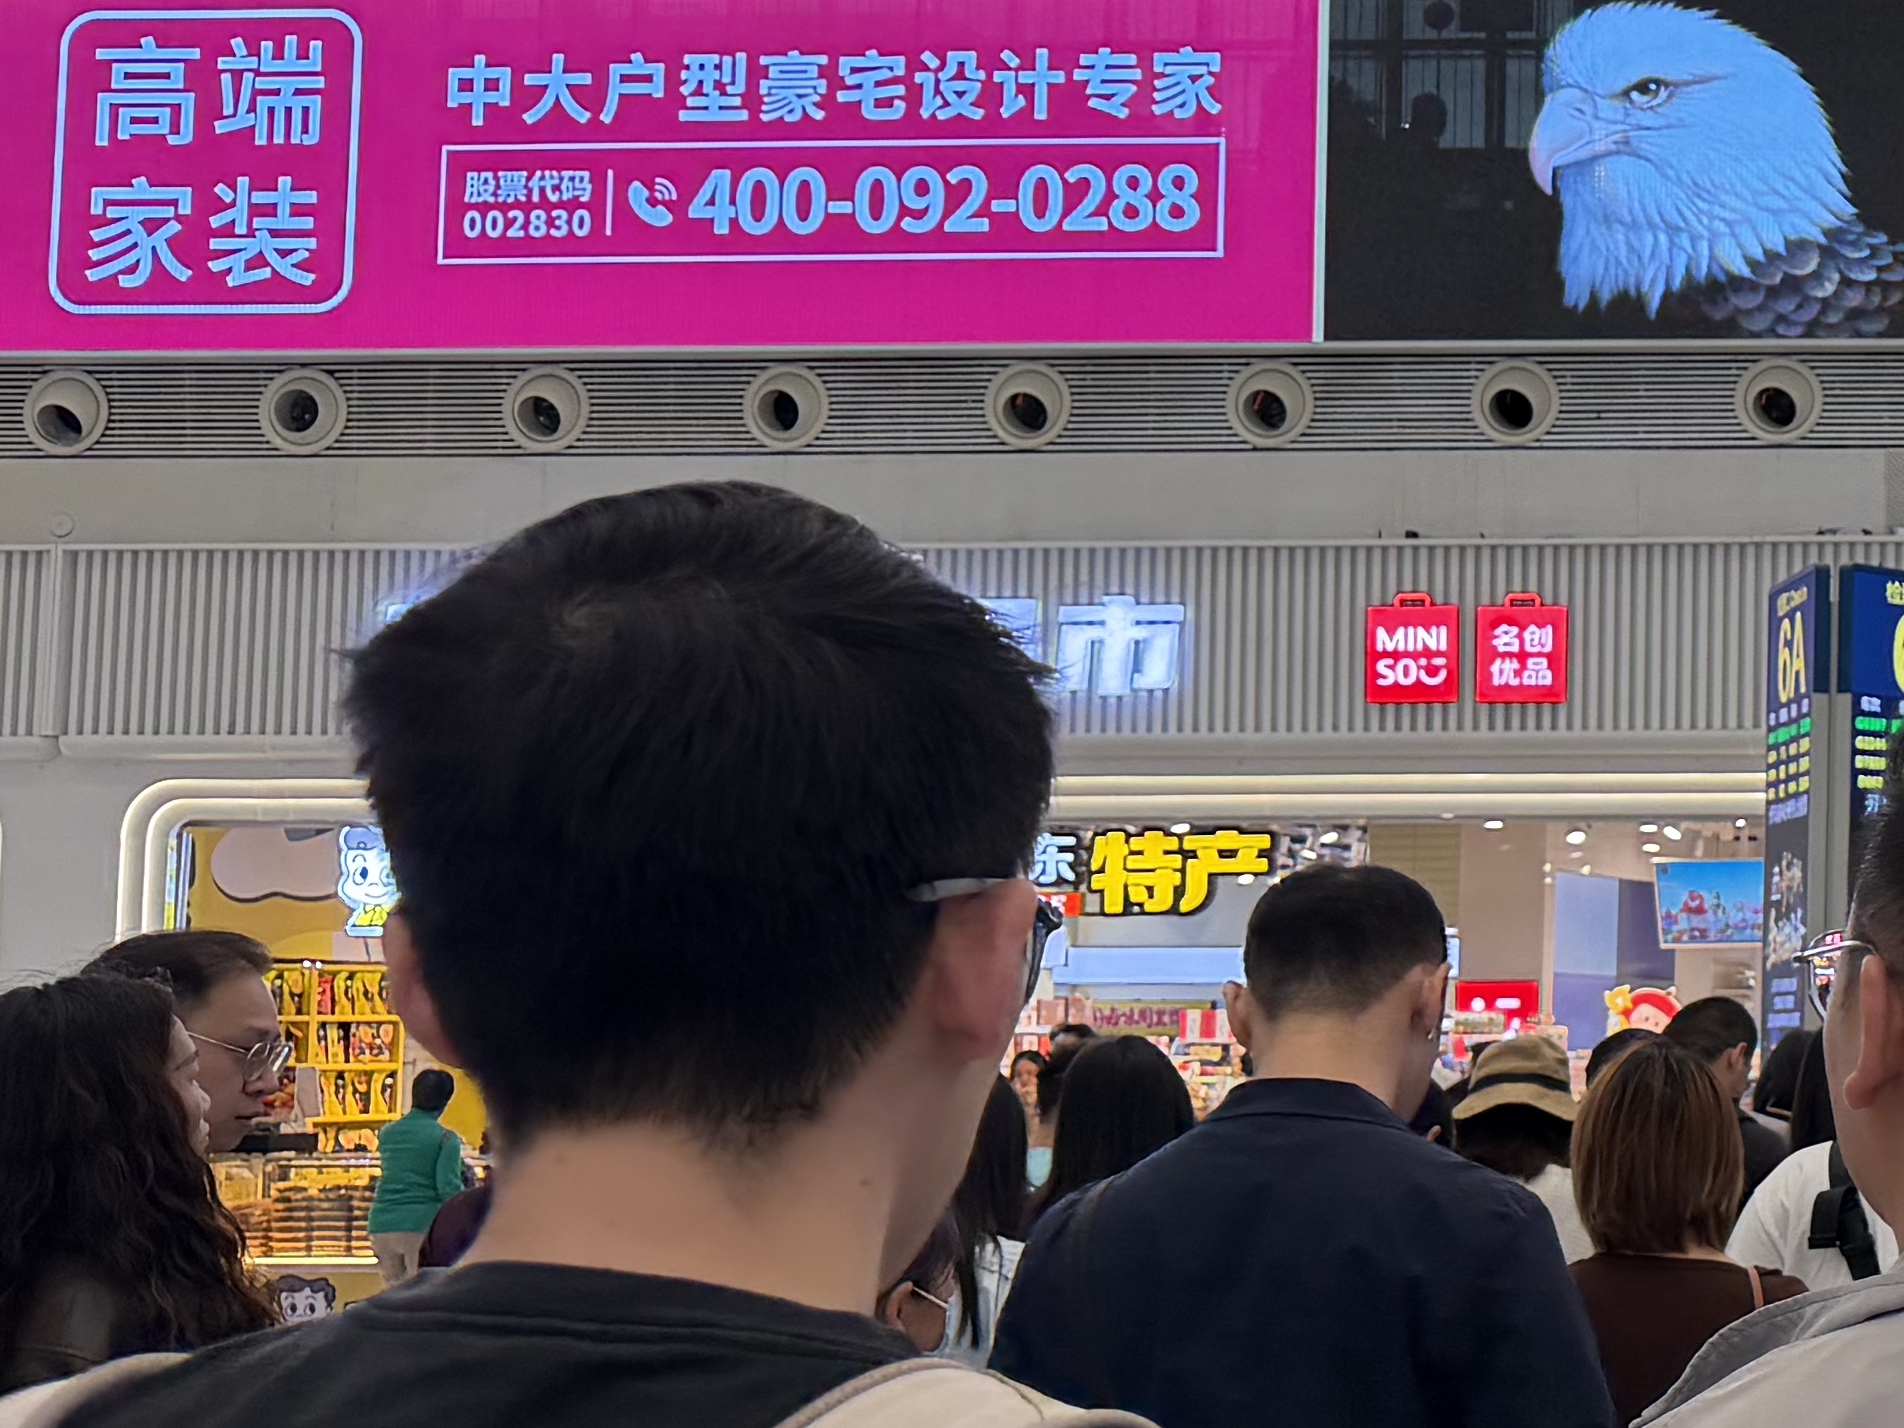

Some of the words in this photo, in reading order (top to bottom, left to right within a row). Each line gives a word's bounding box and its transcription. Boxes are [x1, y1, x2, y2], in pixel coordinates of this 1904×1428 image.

[95, 36, 326, 147] 高端
[444, 47, 1223, 126] 中大户型豪宅设计专家
[462, 168, 592, 205] 股票代码
[686, 164, 1201, 238] 400-092-0288
[84, 175, 320, 290] 家装
[461, 209, 592, 239] 002830
[1376, 625, 1447, 652] MINI
[1491, 623, 1553, 653] 名创
[1777, 611, 1807, 704] 6A
[1490, 657, 1553, 687] 优品
